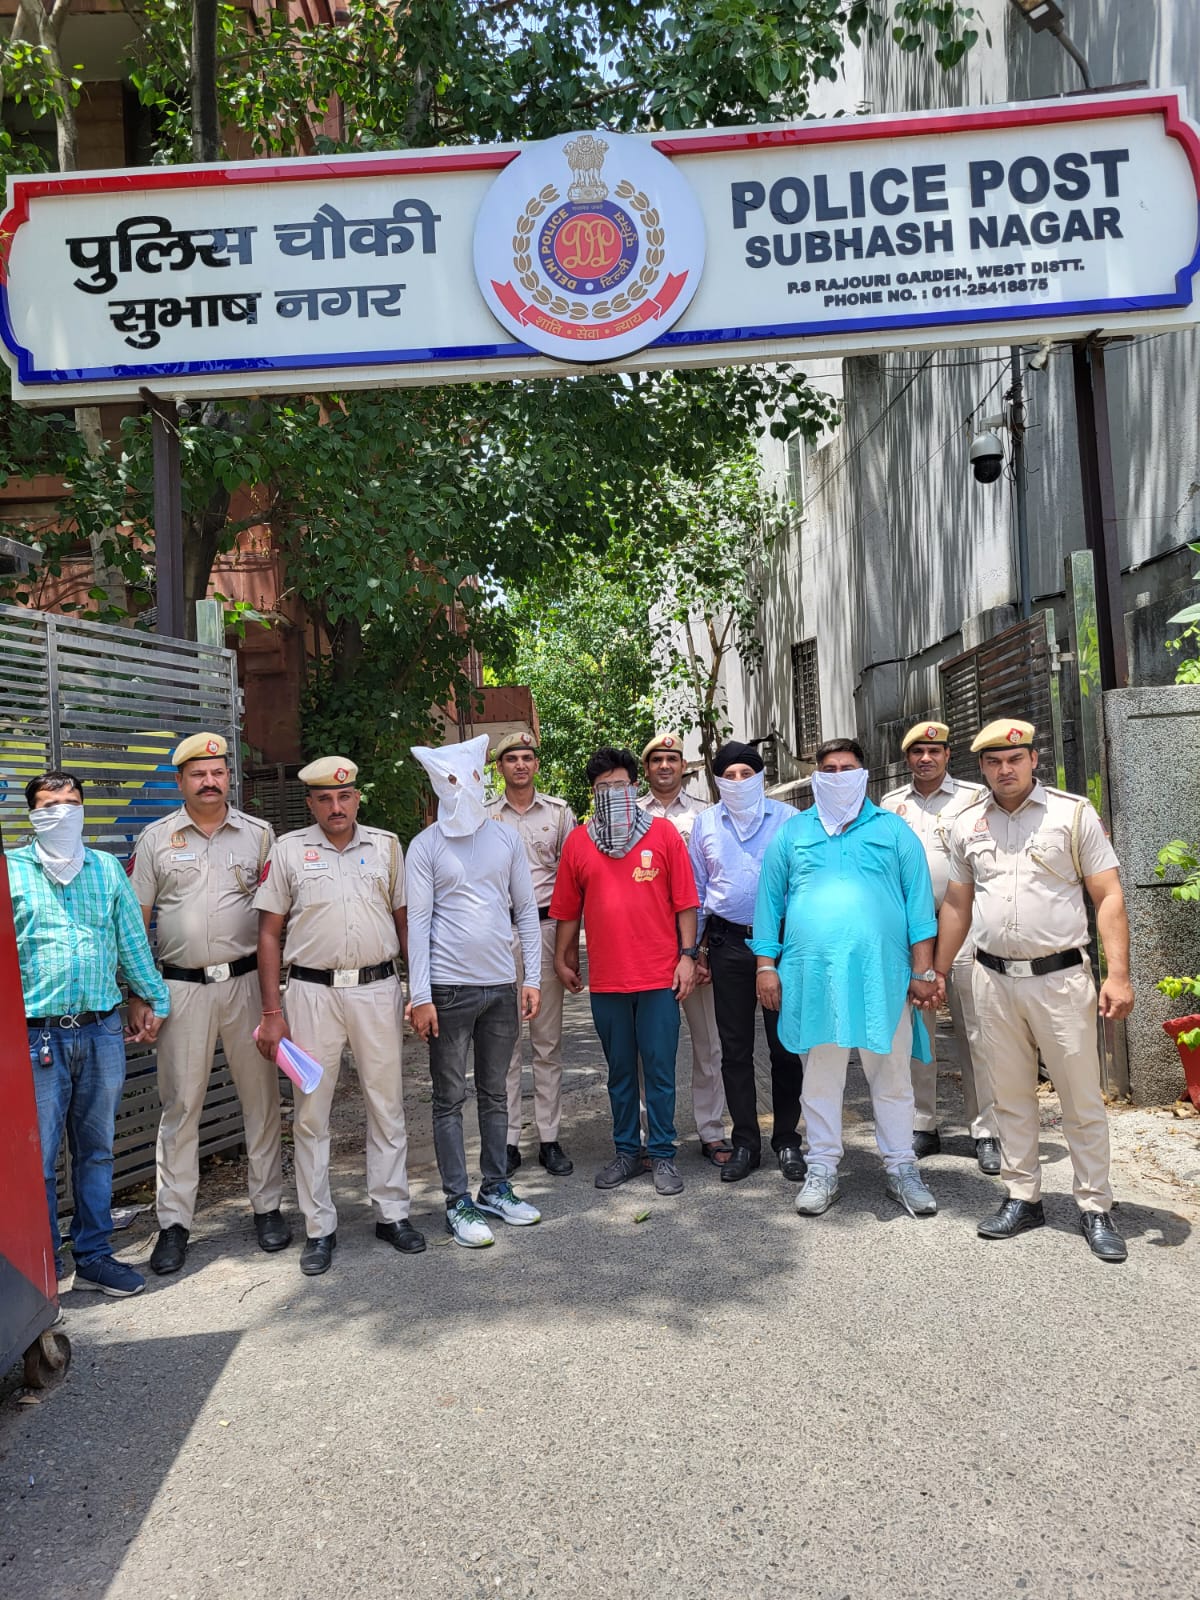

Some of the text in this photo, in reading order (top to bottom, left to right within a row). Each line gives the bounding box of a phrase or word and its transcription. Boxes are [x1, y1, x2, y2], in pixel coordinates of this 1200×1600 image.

[731, 149, 1130, 229] POLICE POST
[65, 199, 441, 294] पुलिस चौकी
[541, 208, 577, 290] DELHI POLICE
[745, 206, 1123, 269] SUBHASH NAGAR
[600, 258, 632, 289] दिल्ली
[815, 273, 891, 291] RAJOURI
[896, 267, 972, 285] GARDEN,
[977, 263, 1026, 278] WEST
[1031, 258, 1085, 274] DISTT.
[824, 291, 883, 307] PHONE
[888, 289, 917, 302] NO.
[932, 278, 1048, 298] 011-25418875
[108, 284, 406, 350] सुभाष नगर
[576, 326, 600, 339] सेवा
[613, 313, 643, 332] न्याय
